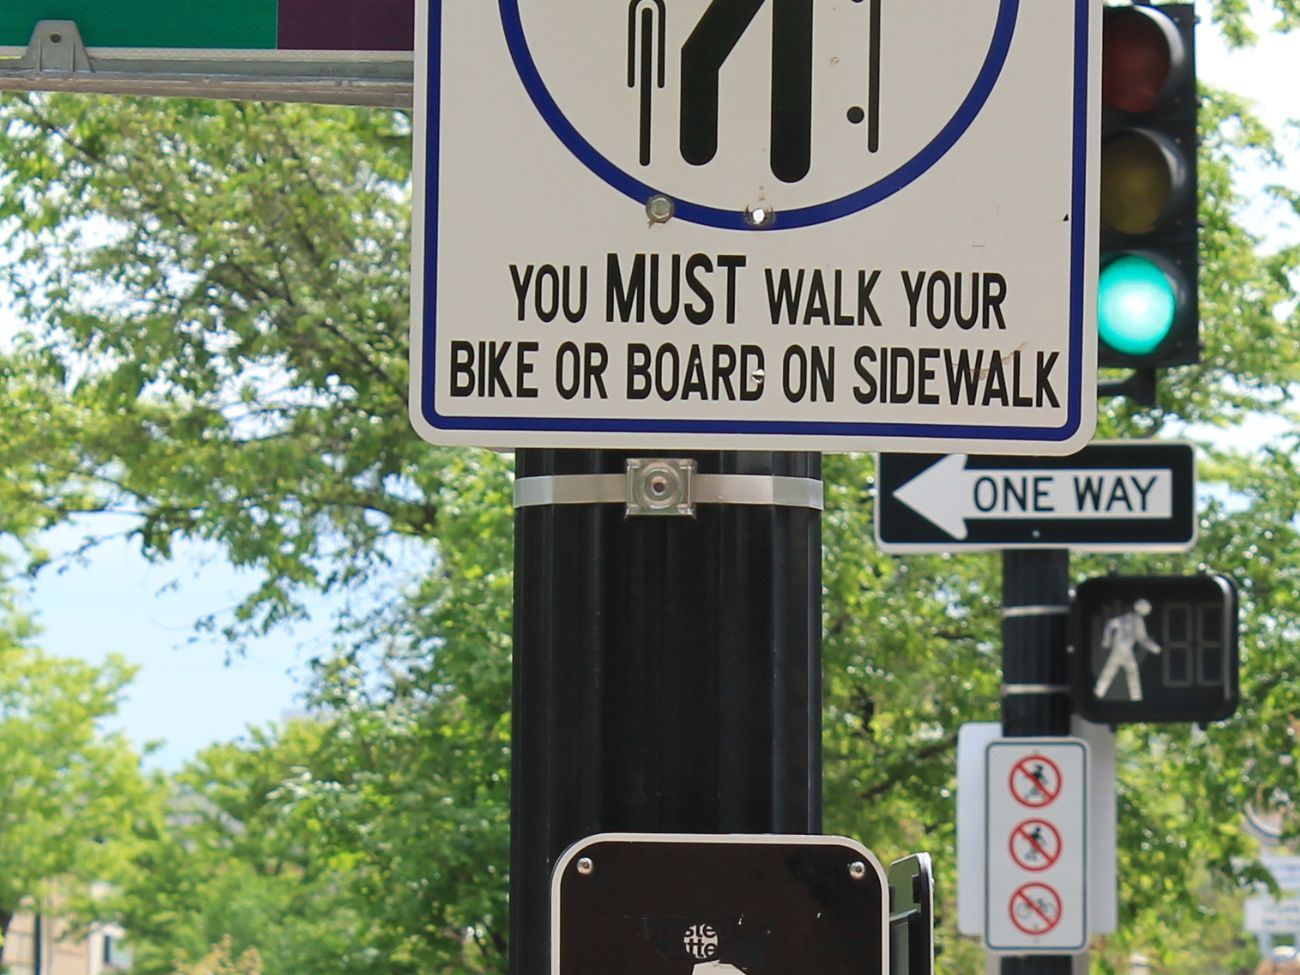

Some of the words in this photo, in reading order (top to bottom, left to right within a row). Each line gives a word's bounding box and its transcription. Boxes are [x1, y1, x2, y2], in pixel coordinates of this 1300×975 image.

[509, 264, 588, 323] YOU
[605, 253, 747, 325] MUST
[764, 268, 882, 327] WALK
[900, 270, 1008, 330] YOUR
[450, 340, 539, 398] BIKE
[555, 341, 609, 399] OR
[626, 342, 766, 401] BOARD
[782, 344, 835, 403] ON
[852, 345, 1061, 408] SIDEWALK
[973, 476, 1054, 512] ONE
[1073, 476, 1157, 512] WAY
